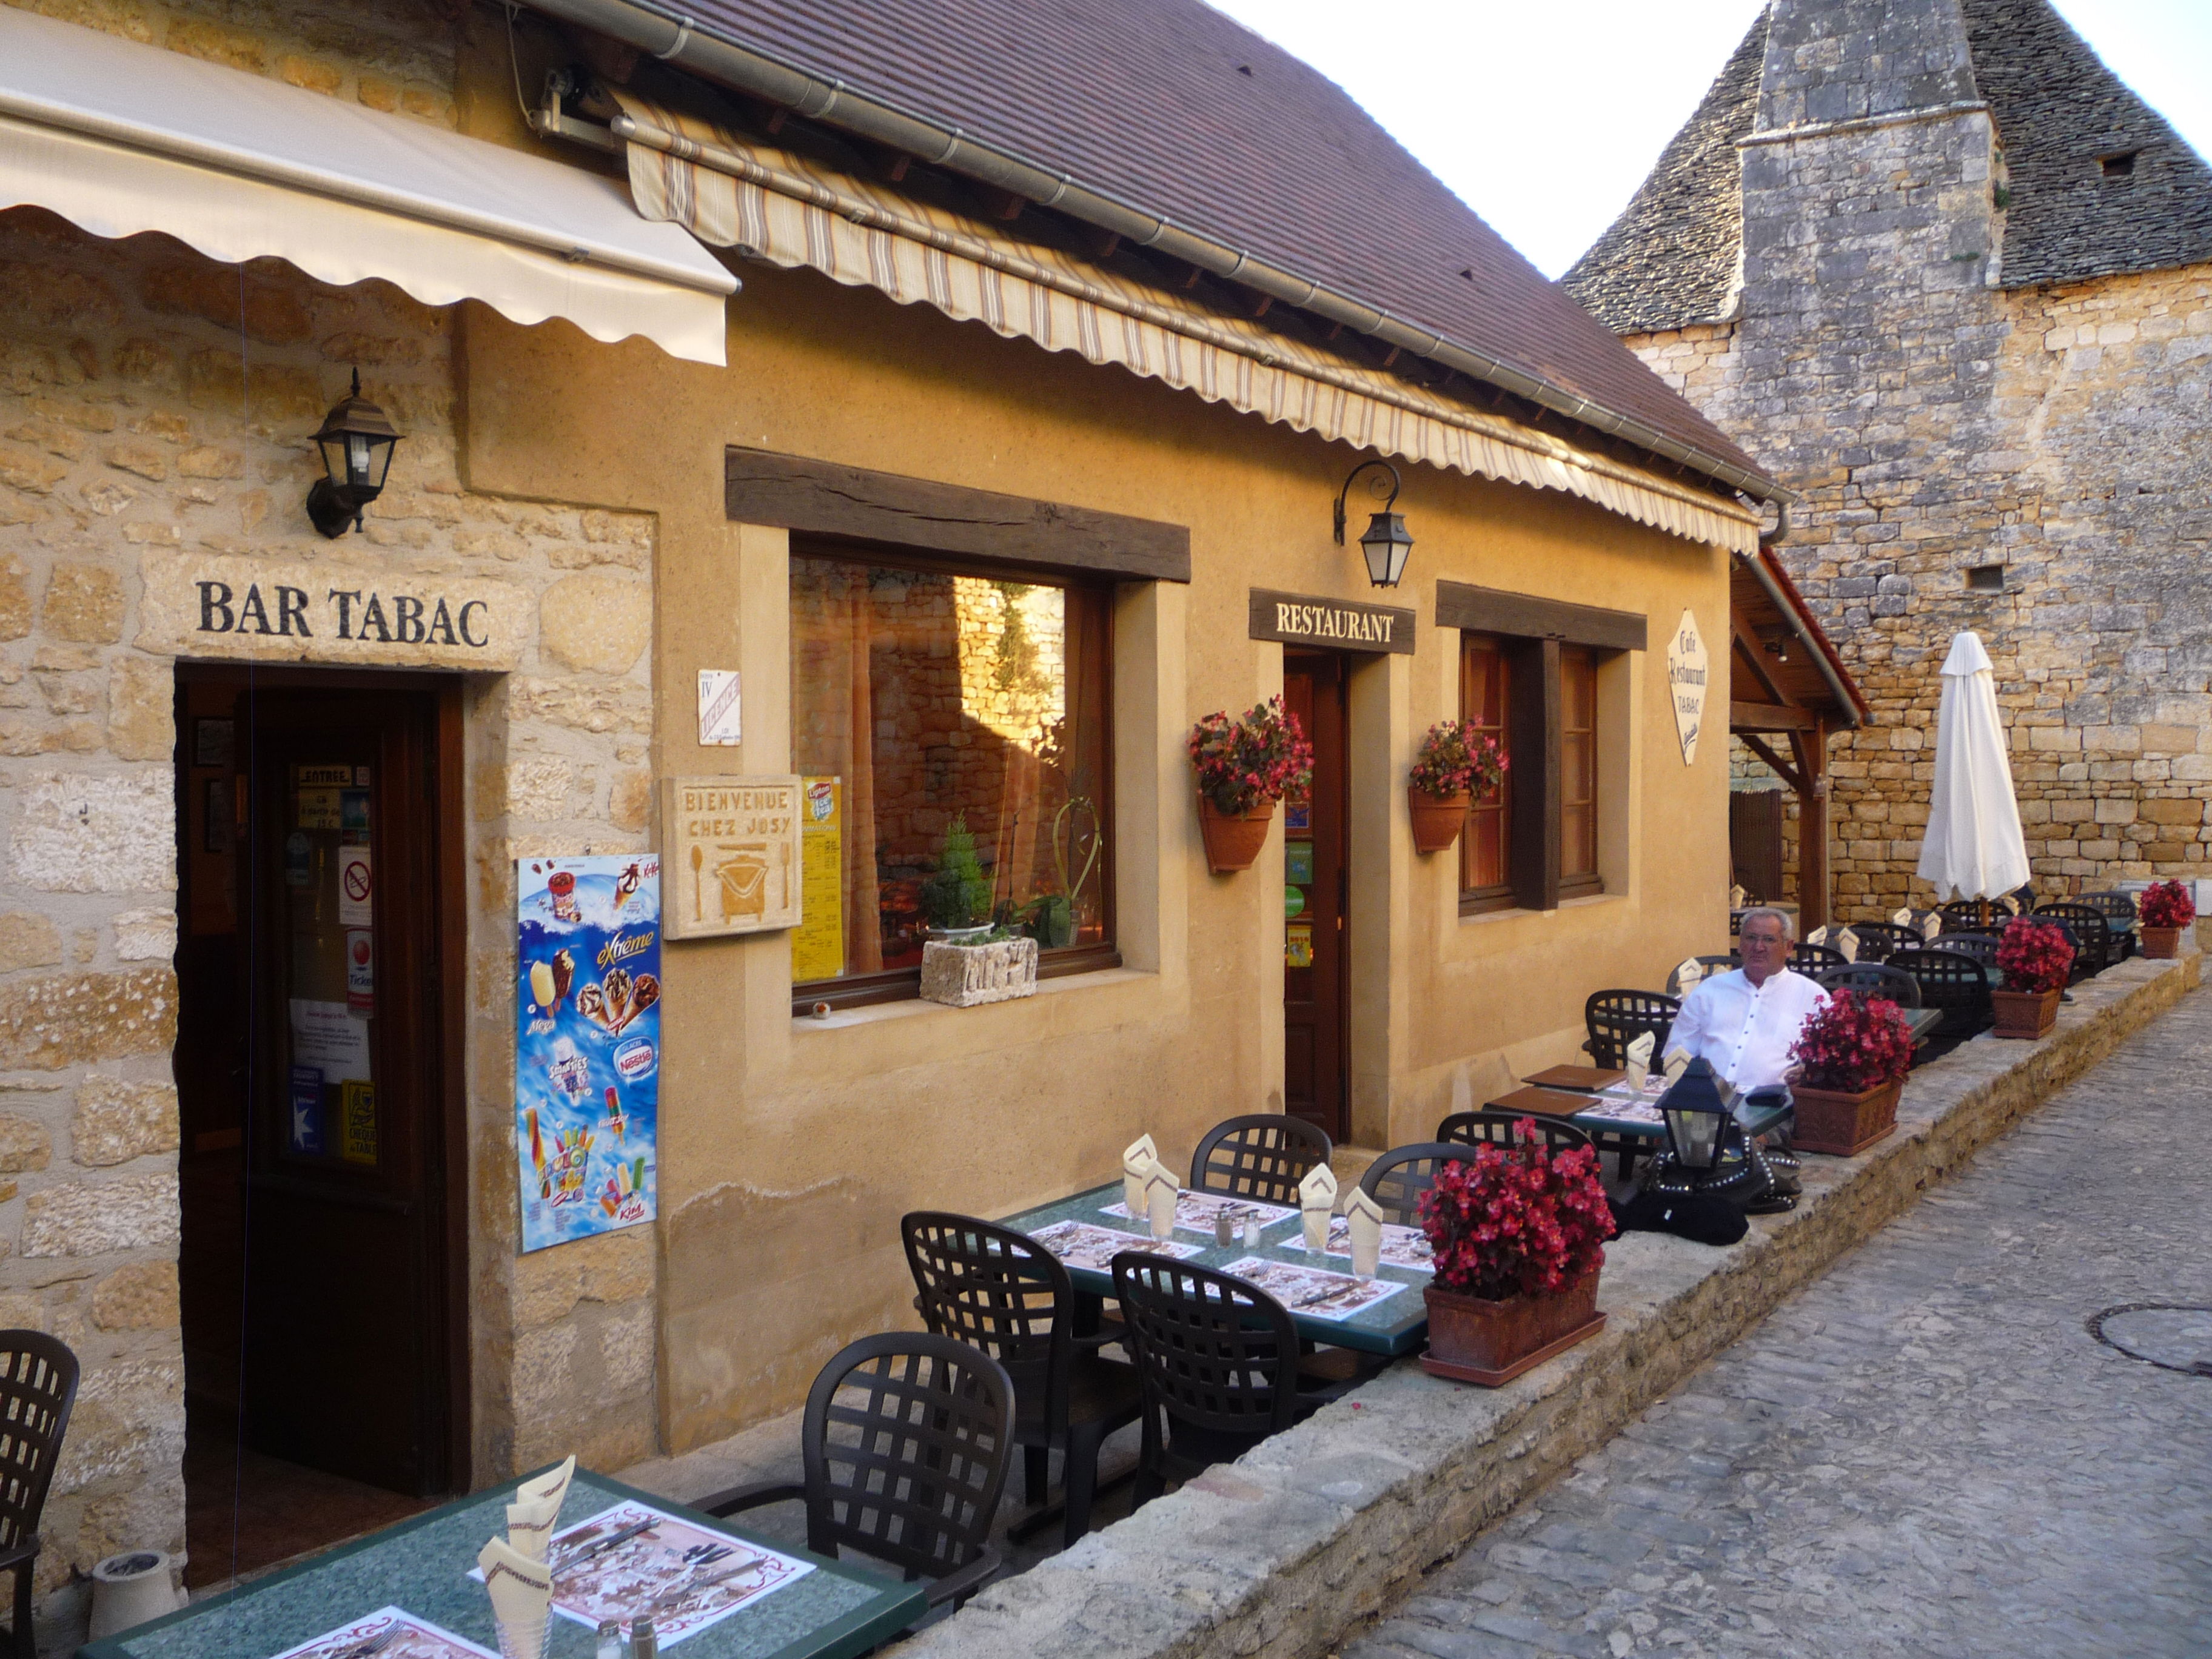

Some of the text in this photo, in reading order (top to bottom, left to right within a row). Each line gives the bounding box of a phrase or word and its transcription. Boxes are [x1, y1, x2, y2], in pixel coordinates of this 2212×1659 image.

[195, 581, 489, 648] BAR TABAC
[1276, 603, 1394, 643] RESTAURANT
[1680, 631, 1696, 654] Café
[1670, 657, 1705, 686] Restaurant
[702, 681, 712, 698] IV
[700, 677, 739, 739] LICENCE
[1678, 695, 1699, 714] TABAC
[686, 791, 788, 811] BIENVENUE
[808, 784, 830, 798] Lipton
[815, 797, 828, 806] Ice
[689, 817, 791, 837] CHEZ JOSY
[526, 1019, 555, 1035] Mega
[620, 1049, 651, 1073] Nestlé
